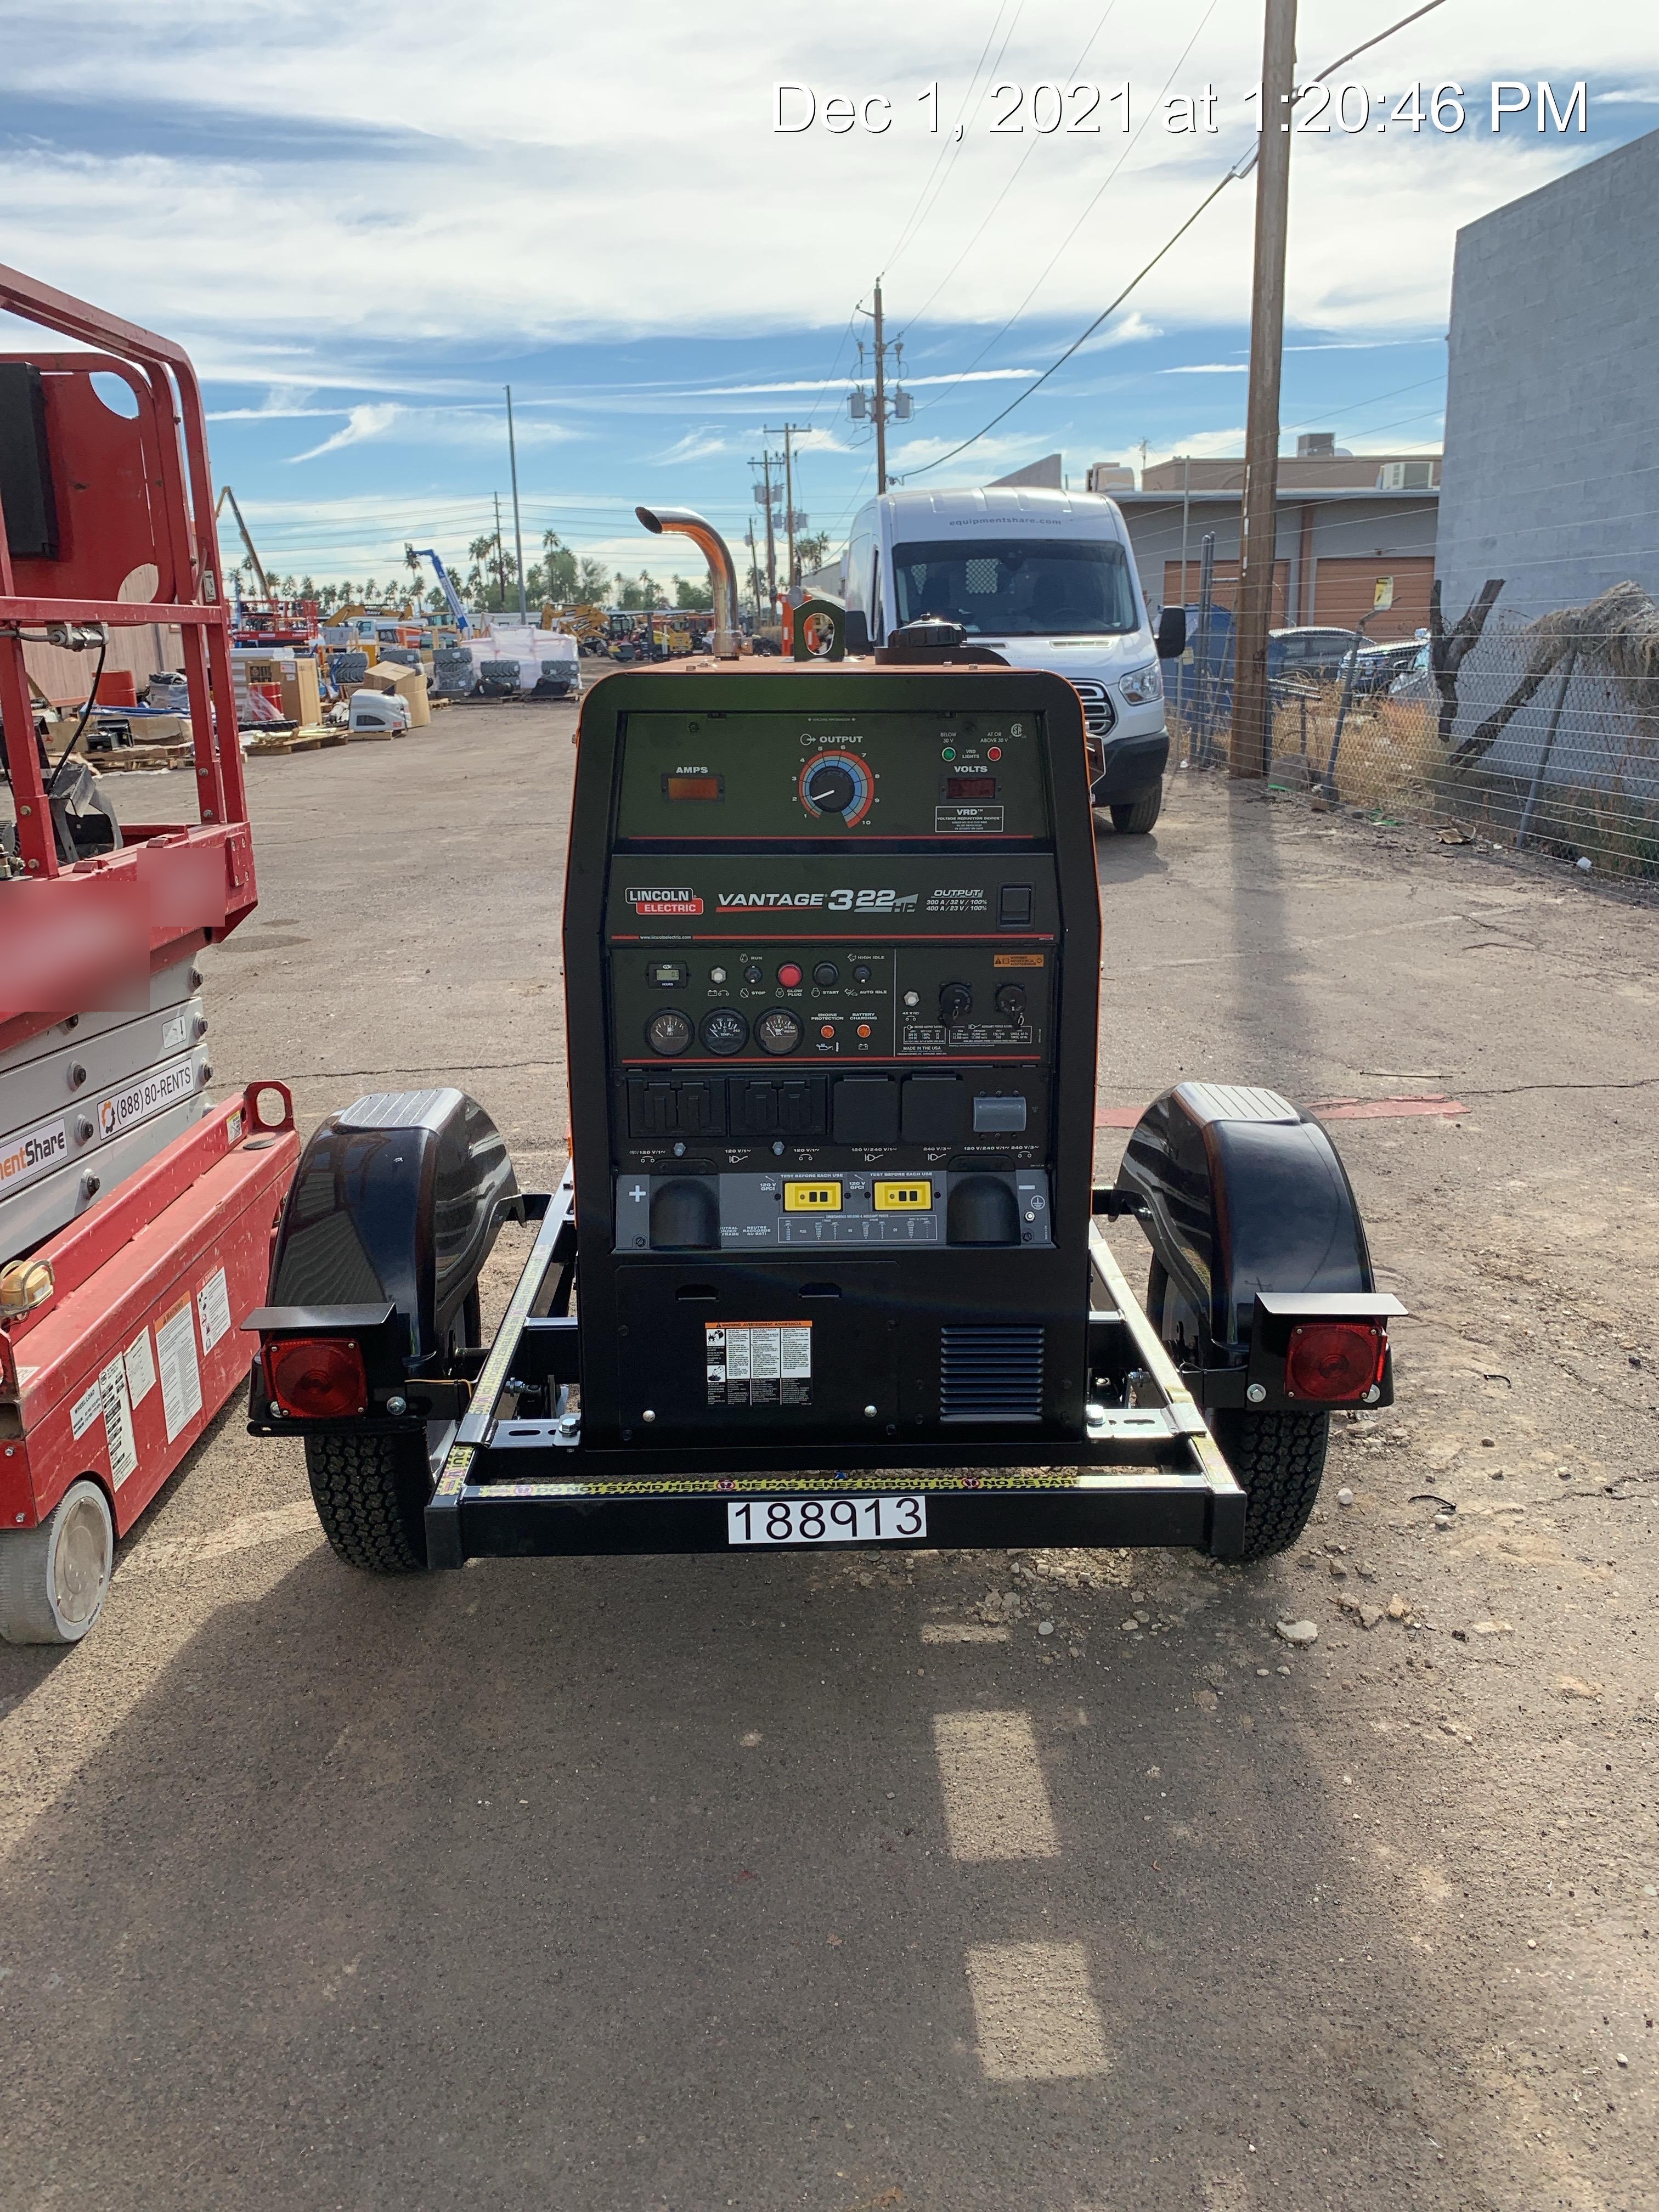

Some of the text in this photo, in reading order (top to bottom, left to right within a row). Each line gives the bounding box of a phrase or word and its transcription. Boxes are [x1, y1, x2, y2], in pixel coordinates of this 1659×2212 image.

[949, 517, 1062, 526] equipmentshare.com
[630, 890, 689, 901] LINCOLN
[718, 889, 897, 911] VANTAGE 322
[644, 904, 696, 912] ELECTRIC
[116, 1066, 191, 1125] (888) 80-RENTS
[527, 1266, 539, 1277] NOT
[521, 1277, 535, 1295] STAND
[515, 1295, 529, 1310] HERE
[510, 1316, 521, 1325] NE
[504, 1325, 517, 1337] PAS
[496, 1338, 513, 1357] TENEZ
[487, 1357, 506, 1385] DEBOUT
[482, 1385, 494, 1395] ICI
[735, 1497, 922, 1541] 188913
